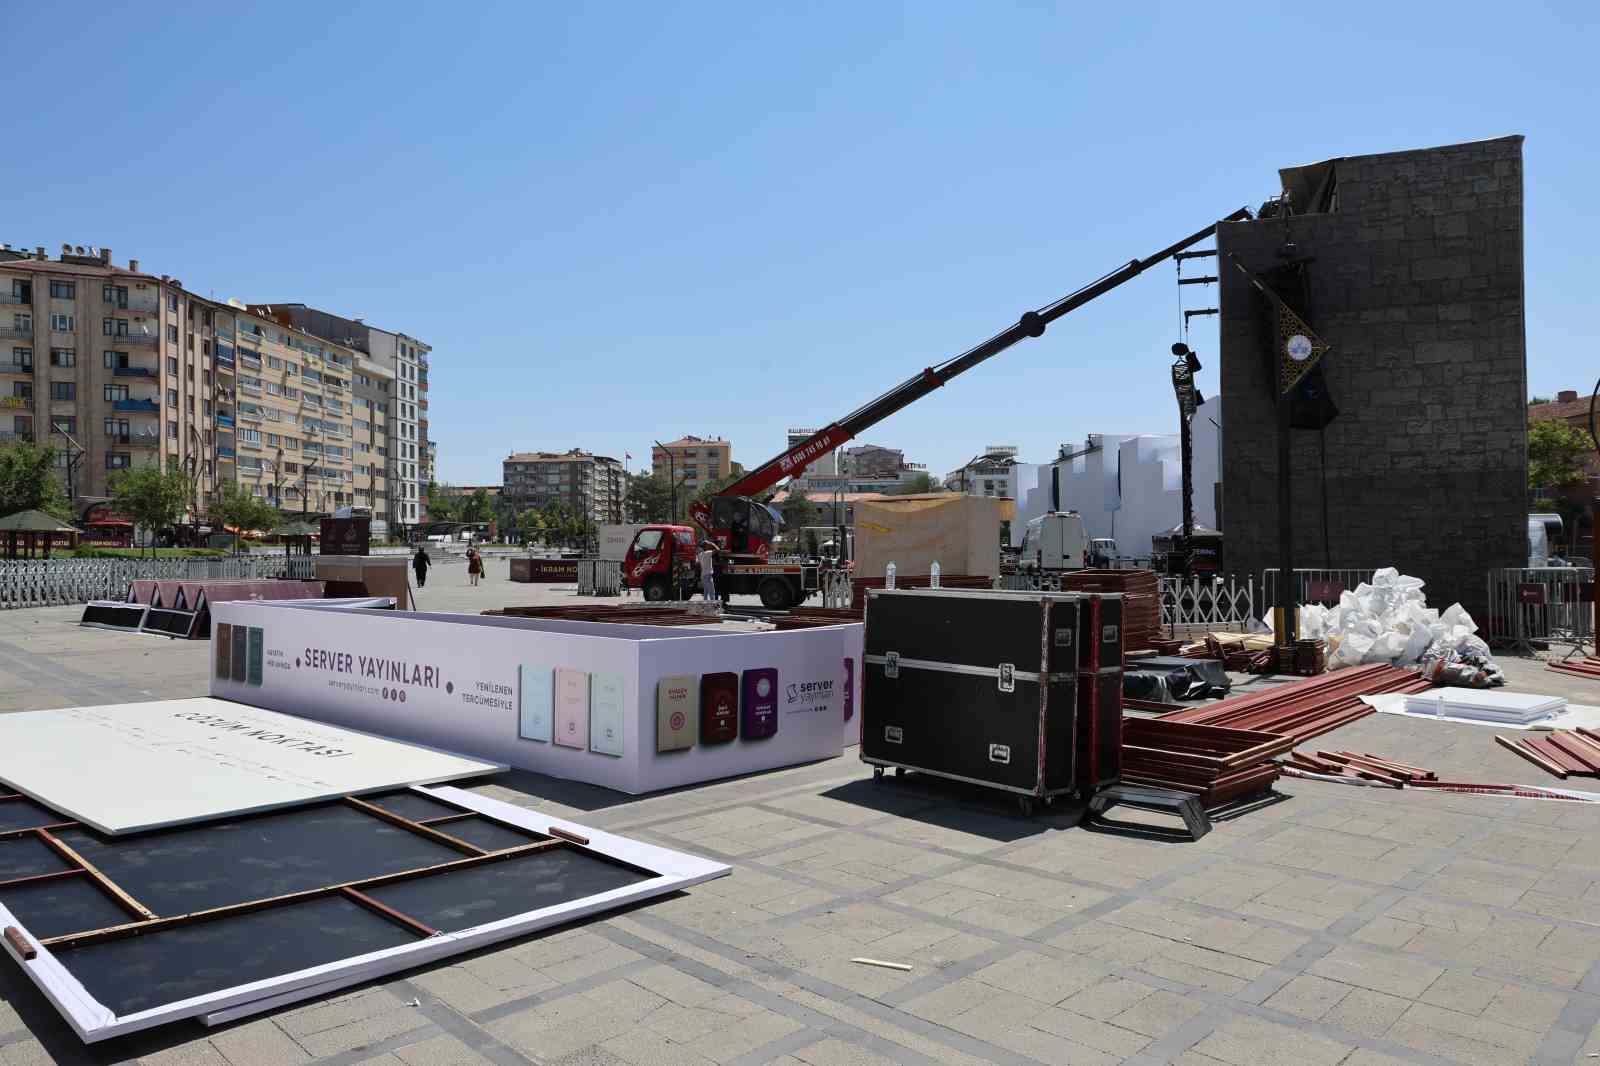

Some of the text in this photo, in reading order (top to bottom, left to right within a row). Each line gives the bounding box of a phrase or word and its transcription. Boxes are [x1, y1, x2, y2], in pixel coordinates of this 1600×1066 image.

[304, 647, 353, 674] SERVER
[358, 655, 441, 689] YAYINLARI
[475, 681, 513, 696] YENİLENEN
[800, 679, 834, 692] server
